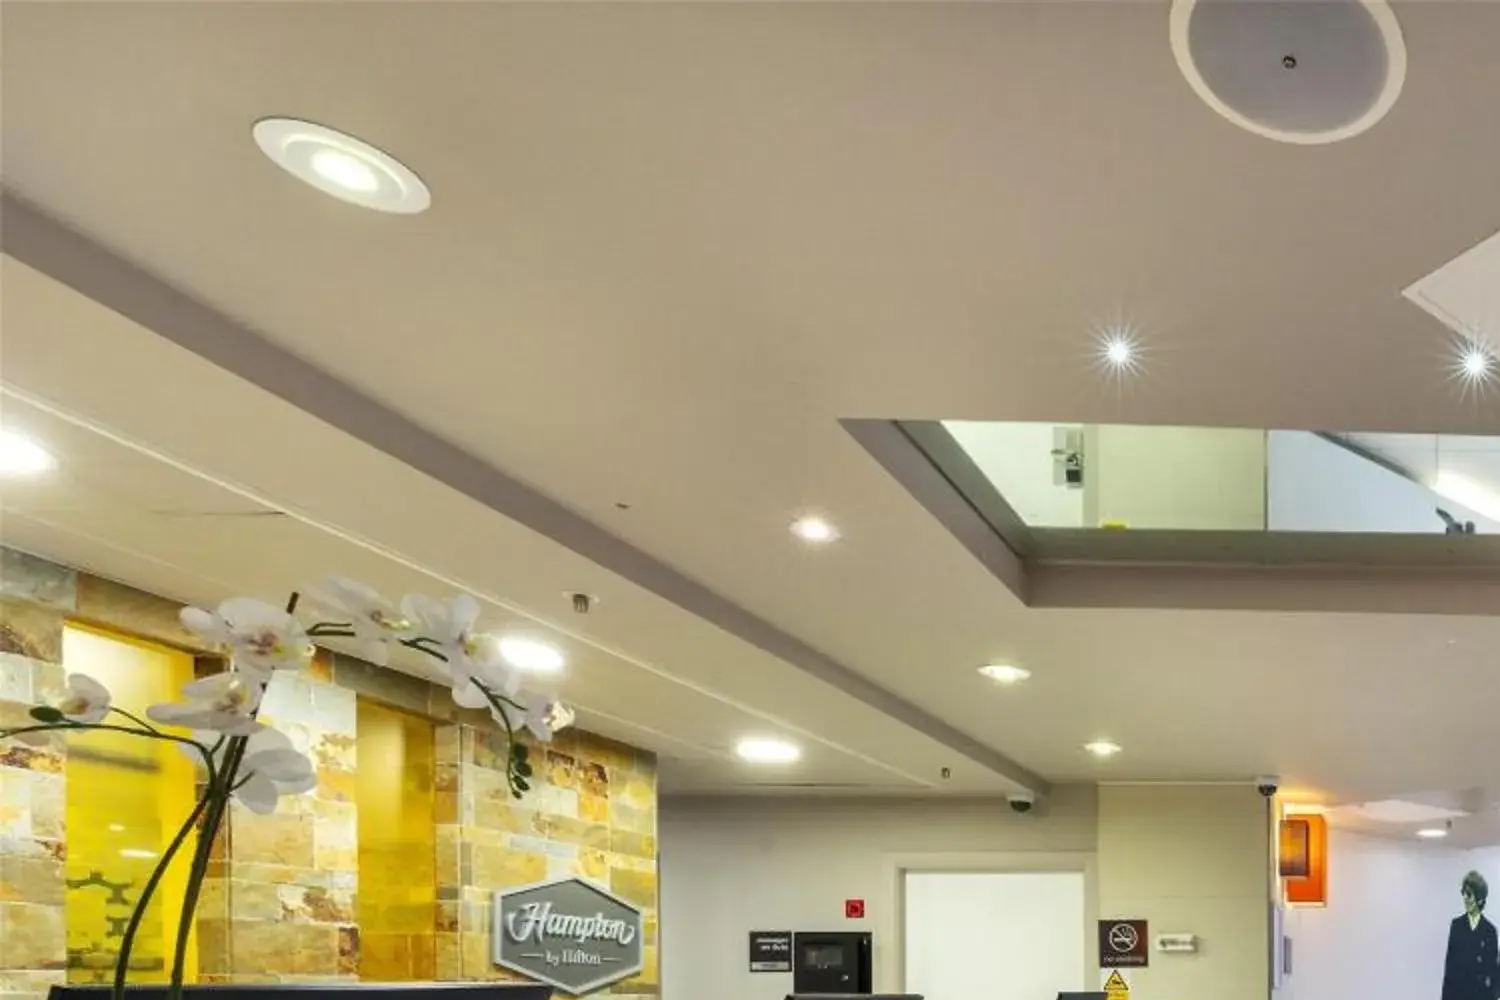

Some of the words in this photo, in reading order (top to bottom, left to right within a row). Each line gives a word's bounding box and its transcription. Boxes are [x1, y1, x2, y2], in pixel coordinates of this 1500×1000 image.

[506, 902, 635, 945] Hampton
[546, 949, 559, 967] by
[562, 949, 601, 964] Hilton
